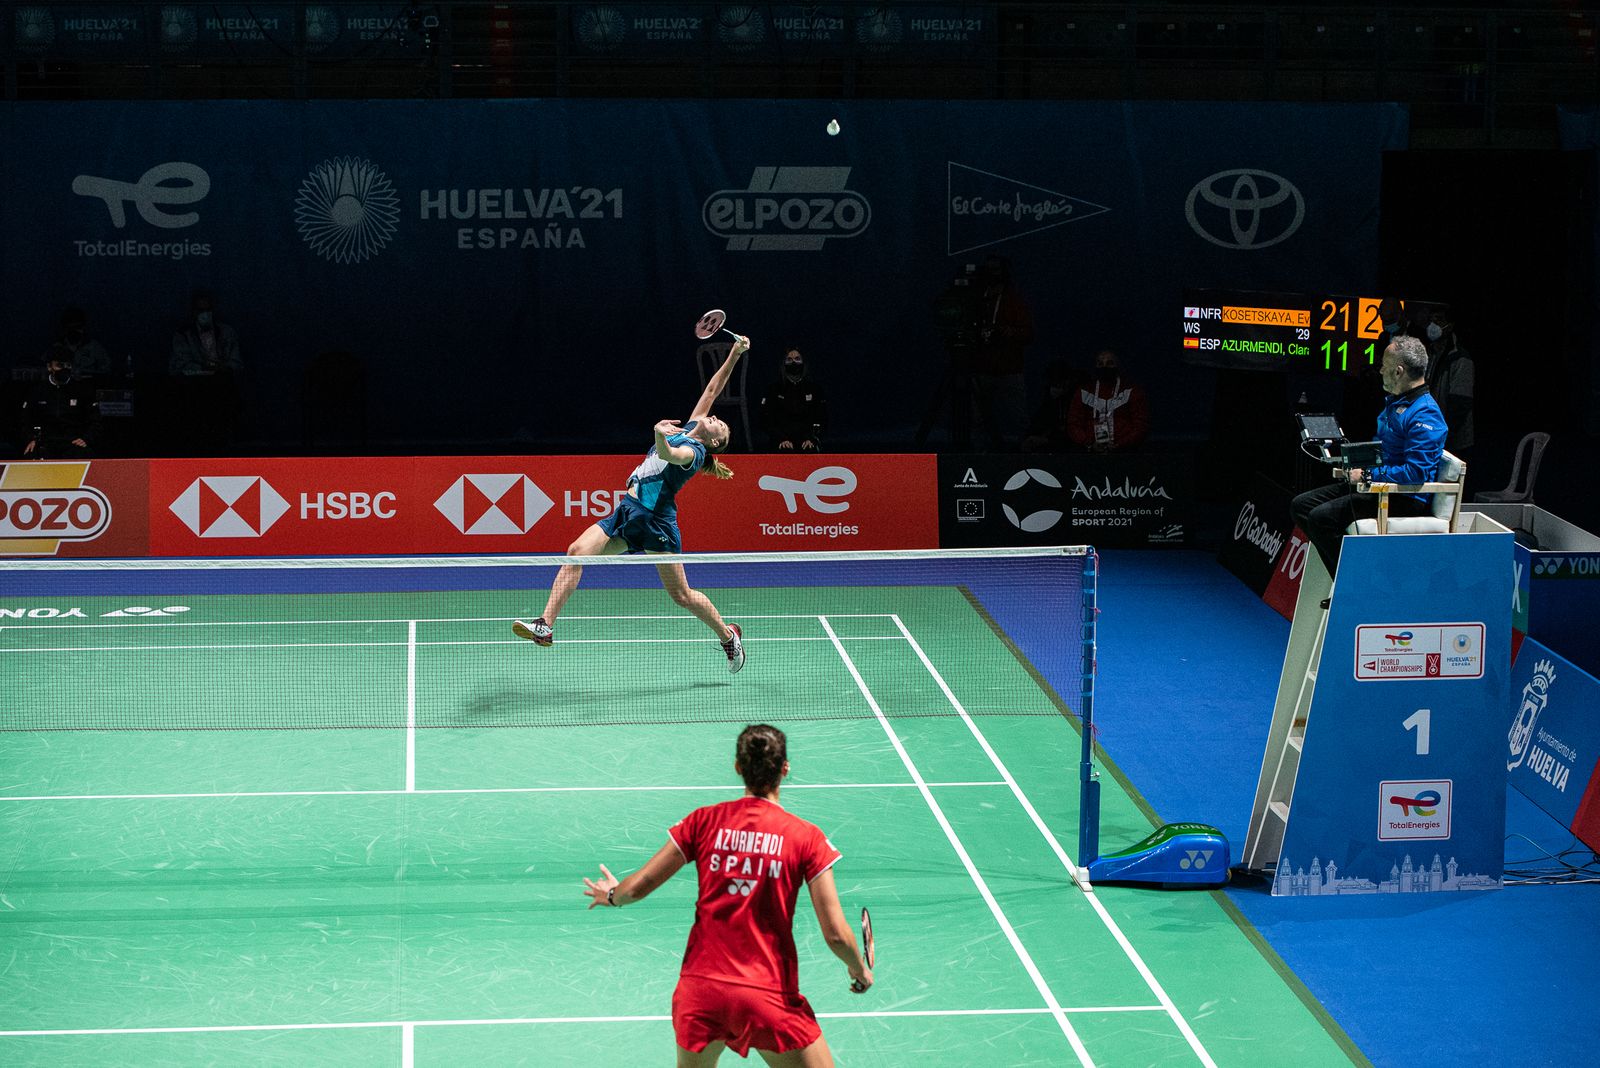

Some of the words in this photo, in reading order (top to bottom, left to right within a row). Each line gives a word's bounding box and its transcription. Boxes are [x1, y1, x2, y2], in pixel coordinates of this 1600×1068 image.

[952, 196, 969, 215] El
[970, 197, 1012, 215] Corte
[457, 223, 586, 249] ESPAÑA
[73, 240, 212, 260] TotalEnergies
[1200, 307, 1221, 320] NFR
[1222, 307, 1295, 324] KOSETSKAYA,
[1320, 300, 1349, 332] 21
[1183, 322, 1200, 334] WS
[1200, 338, 1220, 350] ESP
[1221, 340, 1286, 356] AZURMENDI,
[1321, 340, 1348, 371] 11
[1071, 475, 1173, 500] Andalucía
[300, 491, 397, 519] HSBC
[1072, 507, 1116, 518] European
[1119, 507, 1152, 518] Region
[1154, 507, 1165, 516] of
[759, 523, 859, 538] TotalEnergies
[1072, 518, 1106, 526] SPORT
[1107, 518, 1133, 526] 2021
[1246, 516, 1283, 564] GoDaddy
[1380, 658, 1400, 666] WORLD
[1380, 665, 1423, 673] CHAMPIONSHIPS
[1402, 709, 1431, 755] 1
[1526, 744, 1570, 793] HUELVA
[1389, 820, 1440, 830] TotalEnergies
[714, 828, 784, 857] AZURMENDI
[709, 853, 783, 879] SPAIN
